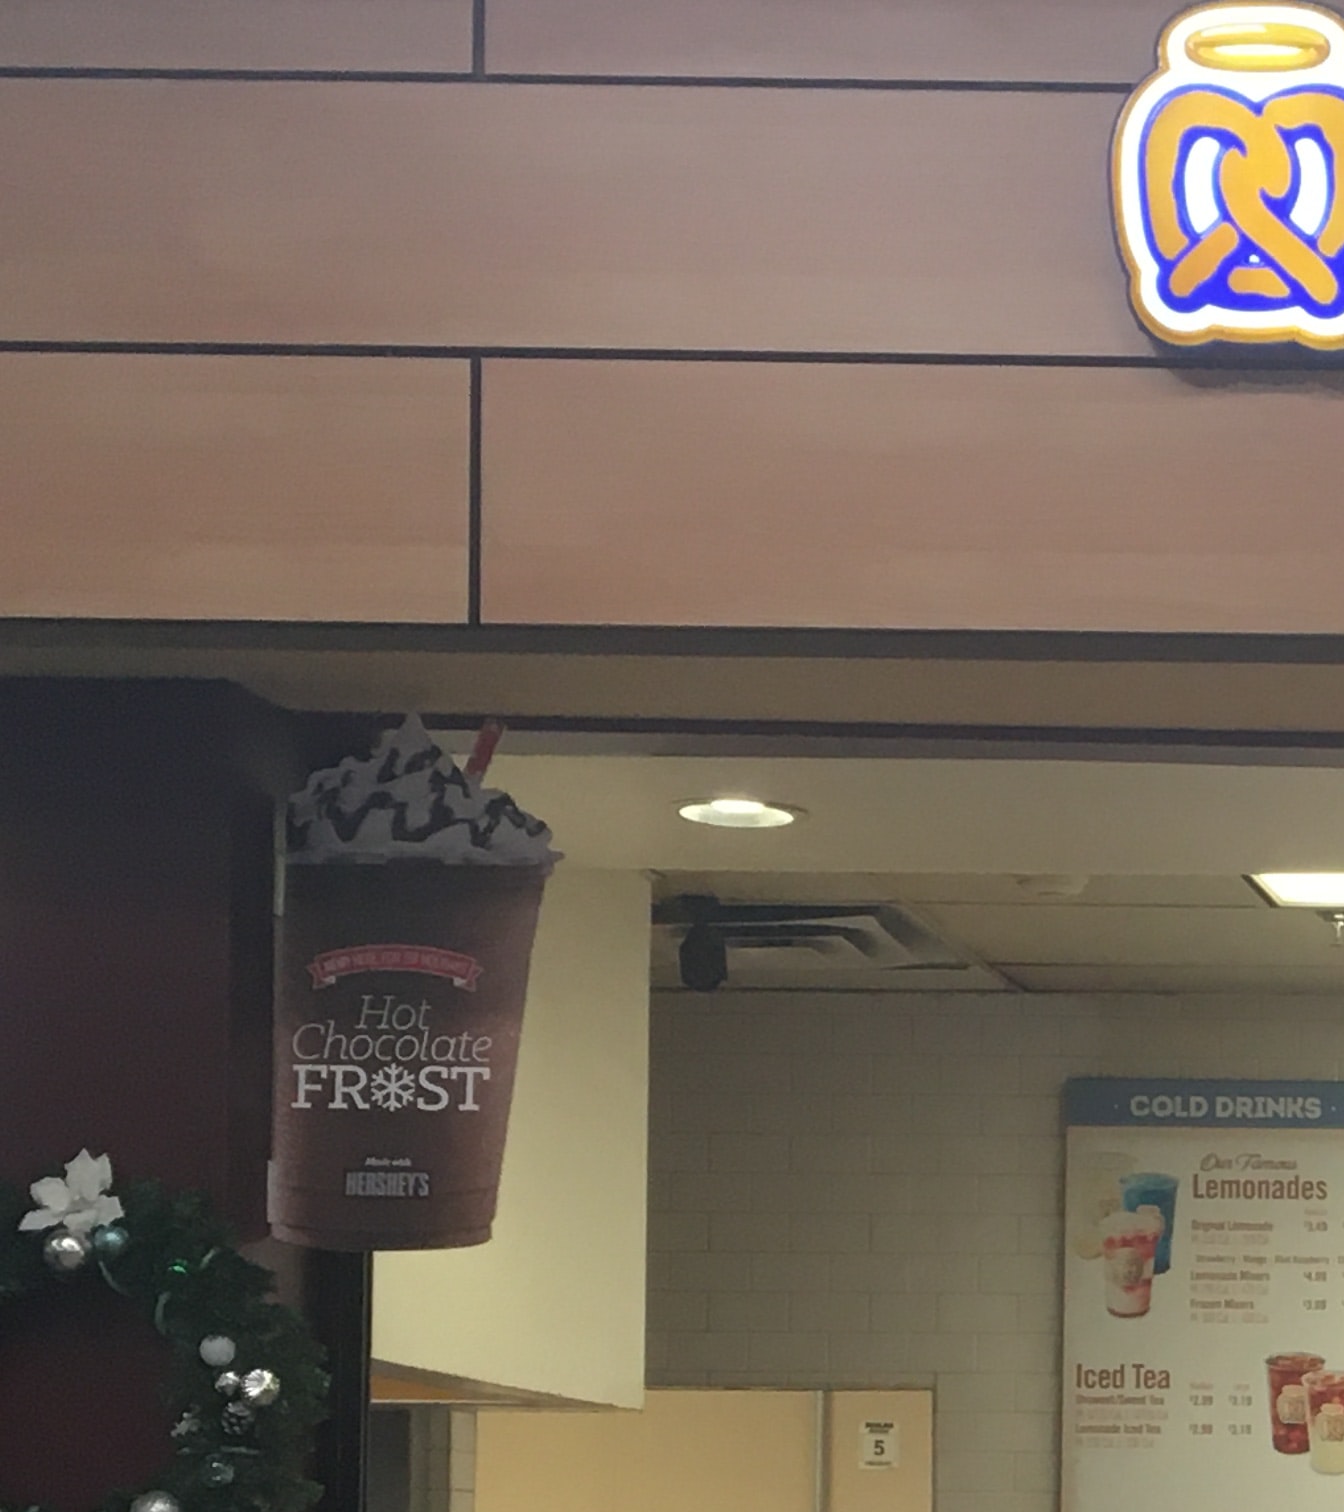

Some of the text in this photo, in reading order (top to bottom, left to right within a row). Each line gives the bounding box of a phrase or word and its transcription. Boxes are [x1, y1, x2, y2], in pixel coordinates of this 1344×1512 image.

[355, 995, 431, 1031] Hot
[292, 1020, 493, 1063] Chocolate
[1130, 1095, 1322, 1119] COLD DRINKS
[1191, 1173, 1329, 1200] Lemonades
[1075, 1363, 1170, 1389] Iced Tea
[874, 1440, 885, 1456] 5
